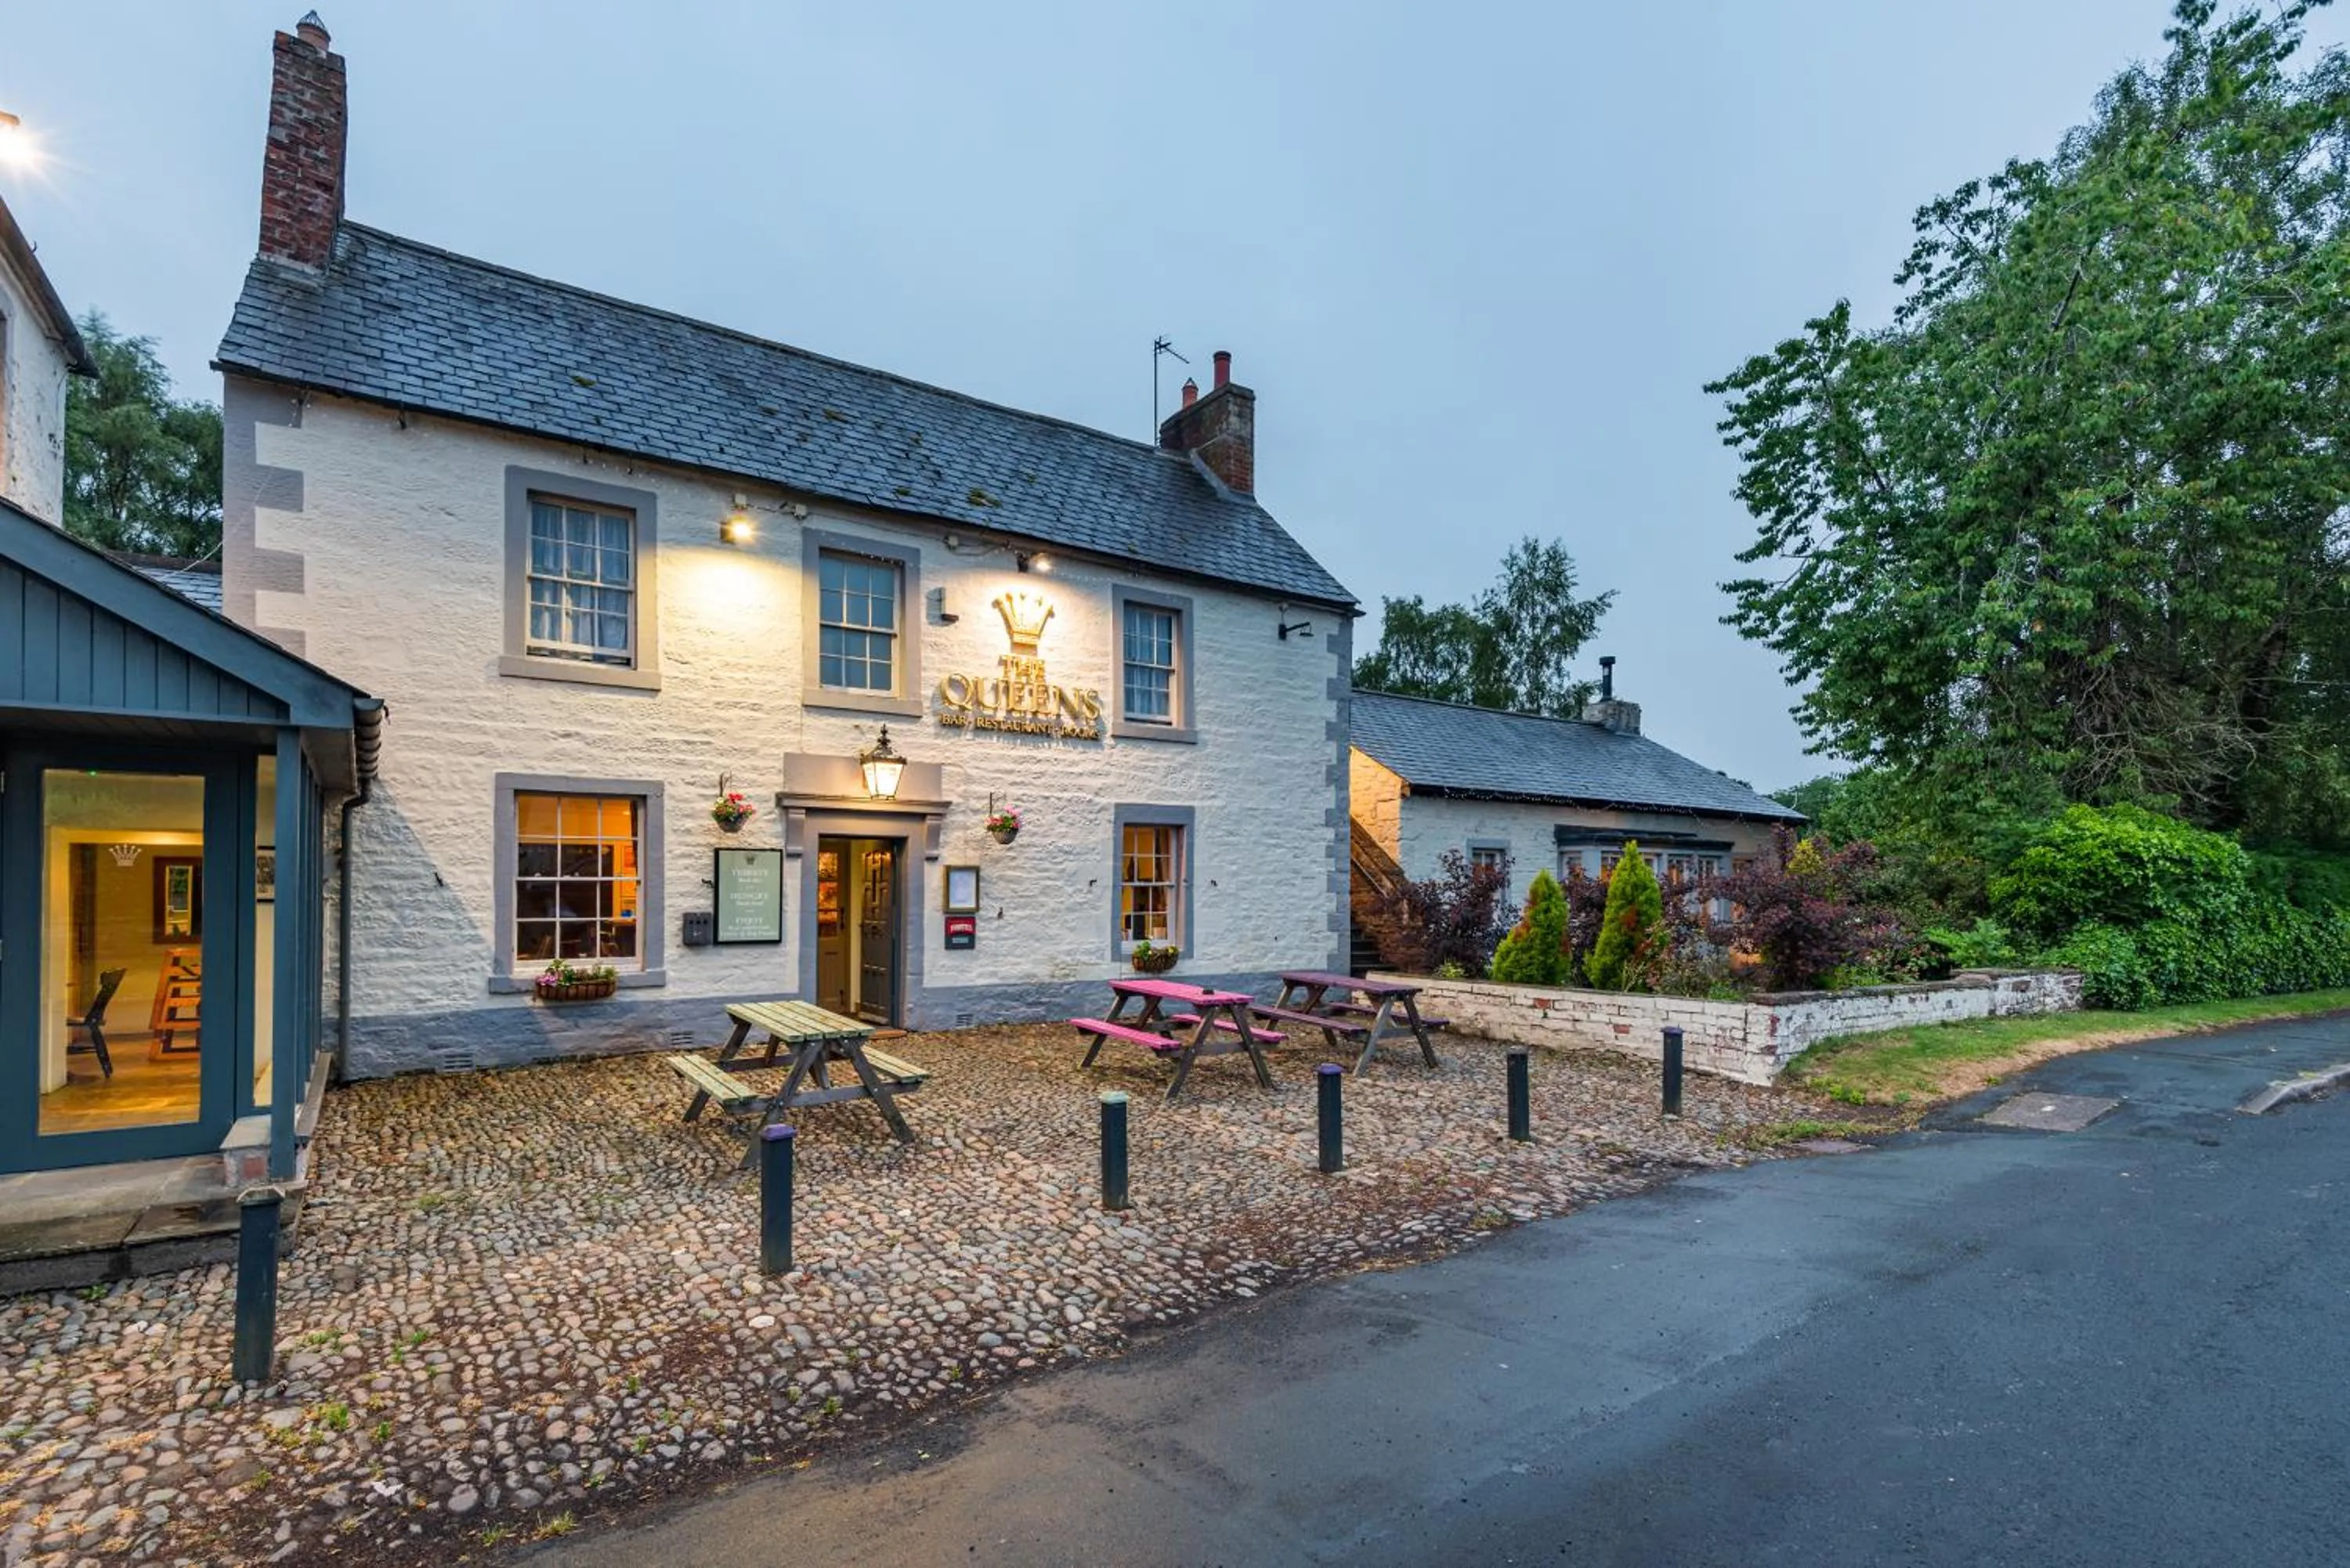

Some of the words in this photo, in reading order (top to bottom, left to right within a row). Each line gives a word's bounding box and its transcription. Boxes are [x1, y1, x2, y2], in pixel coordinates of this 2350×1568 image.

[1000, 655, 1046, 682] THE
[940, 673, 1101, 719] QUEENS
[941, 714, 966, 725] BAR
[977, 717, 1053, 734] RESTAURANT
